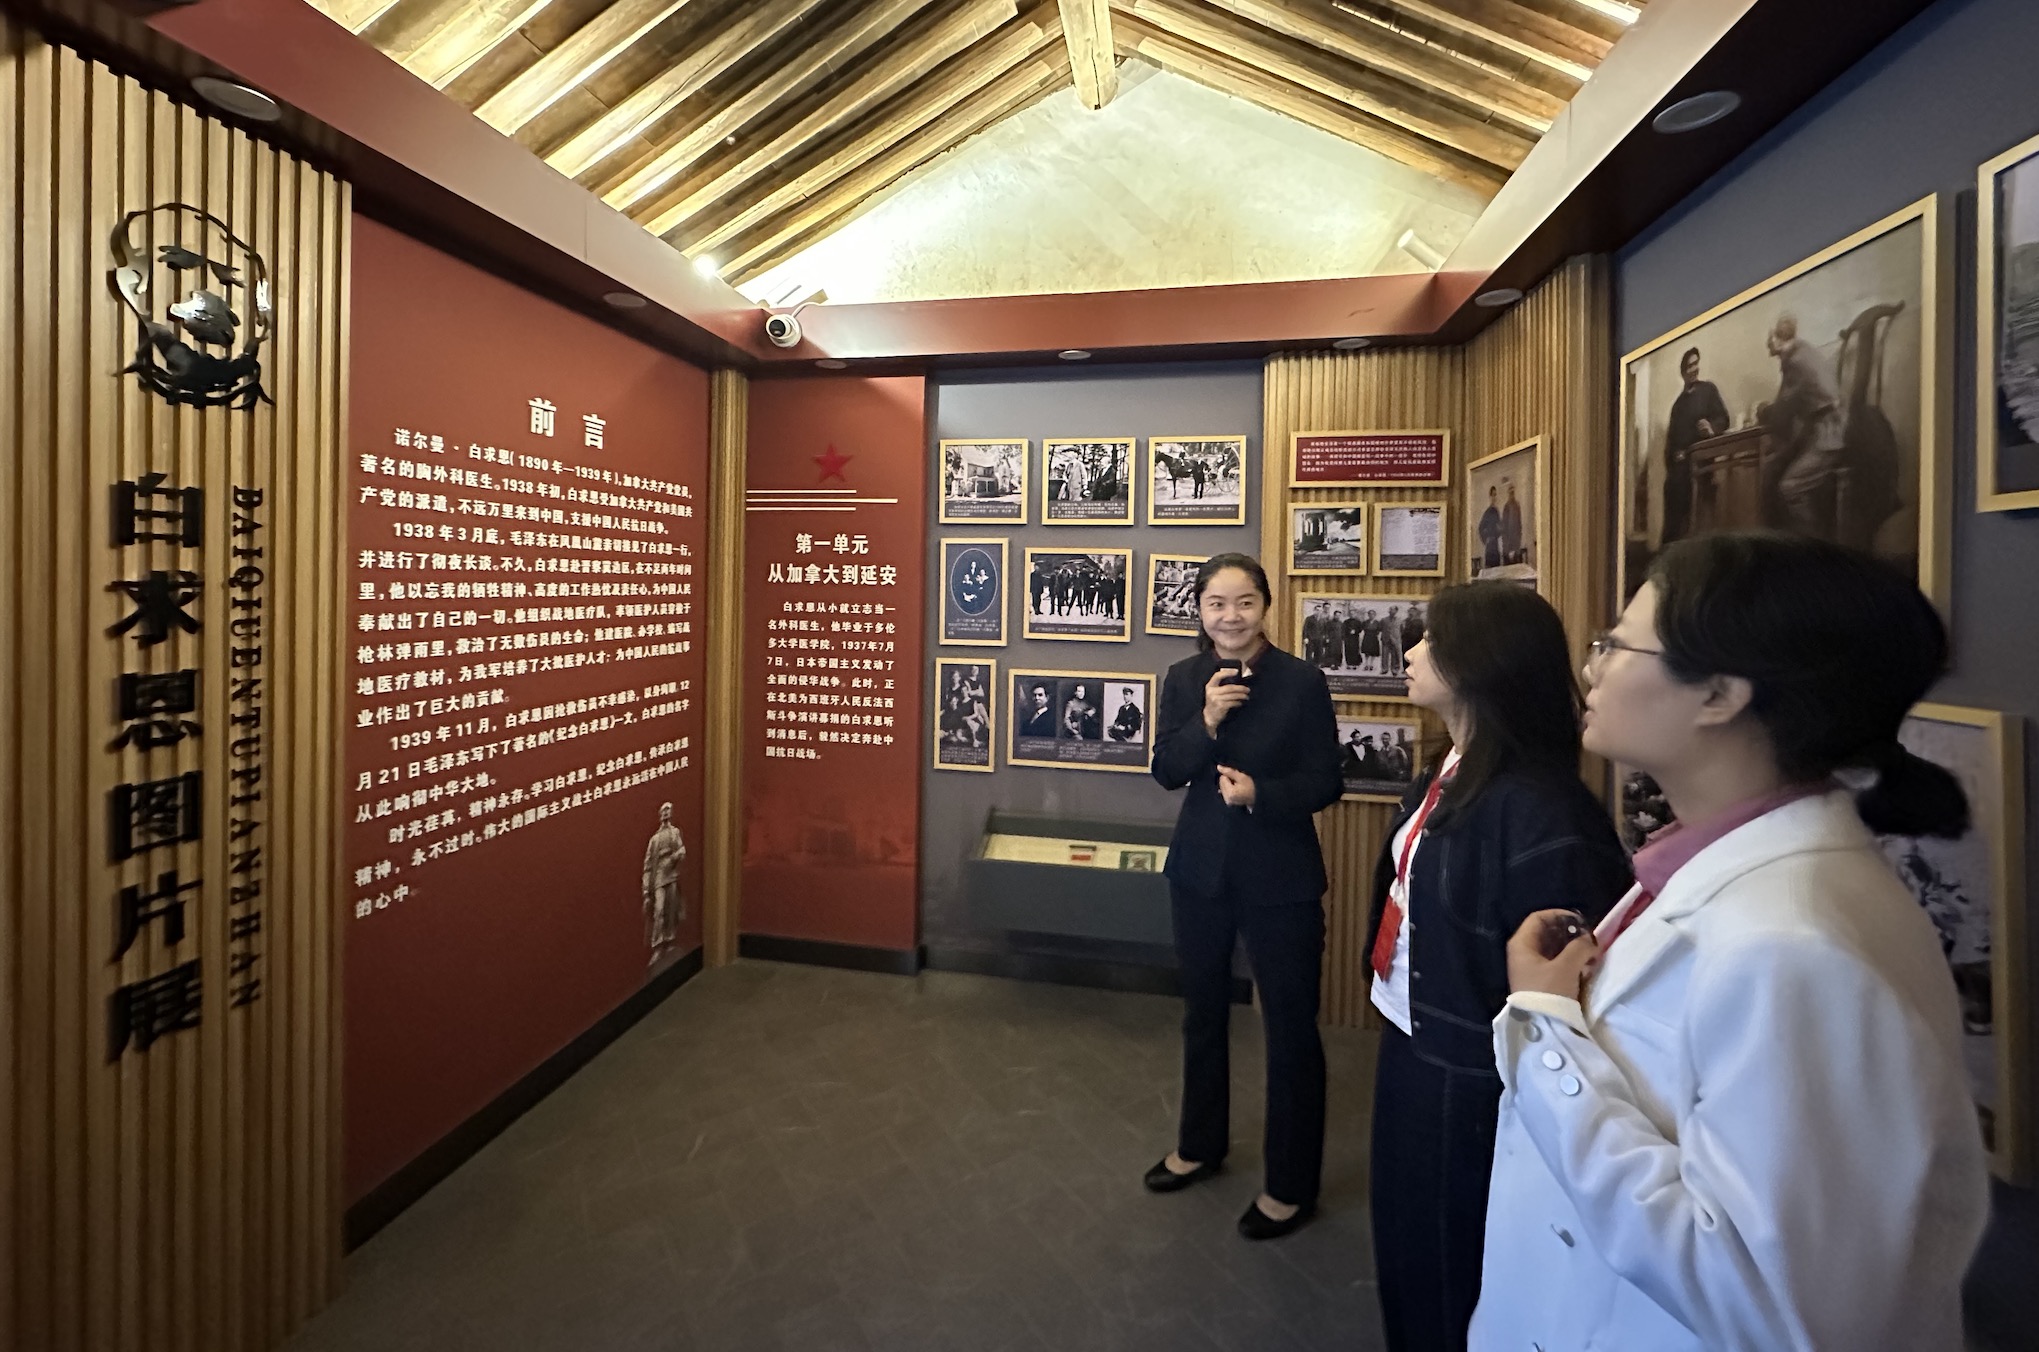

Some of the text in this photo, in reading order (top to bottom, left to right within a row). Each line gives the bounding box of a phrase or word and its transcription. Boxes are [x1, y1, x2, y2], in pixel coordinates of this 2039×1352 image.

[528, 397, 606, 450] 前言
[795, 533, 869, 554] 第一单元
[767, 563, 897, 585] 从加拿大到延安
[783, 602, 896, 614] 白求恩从小就立志当一
